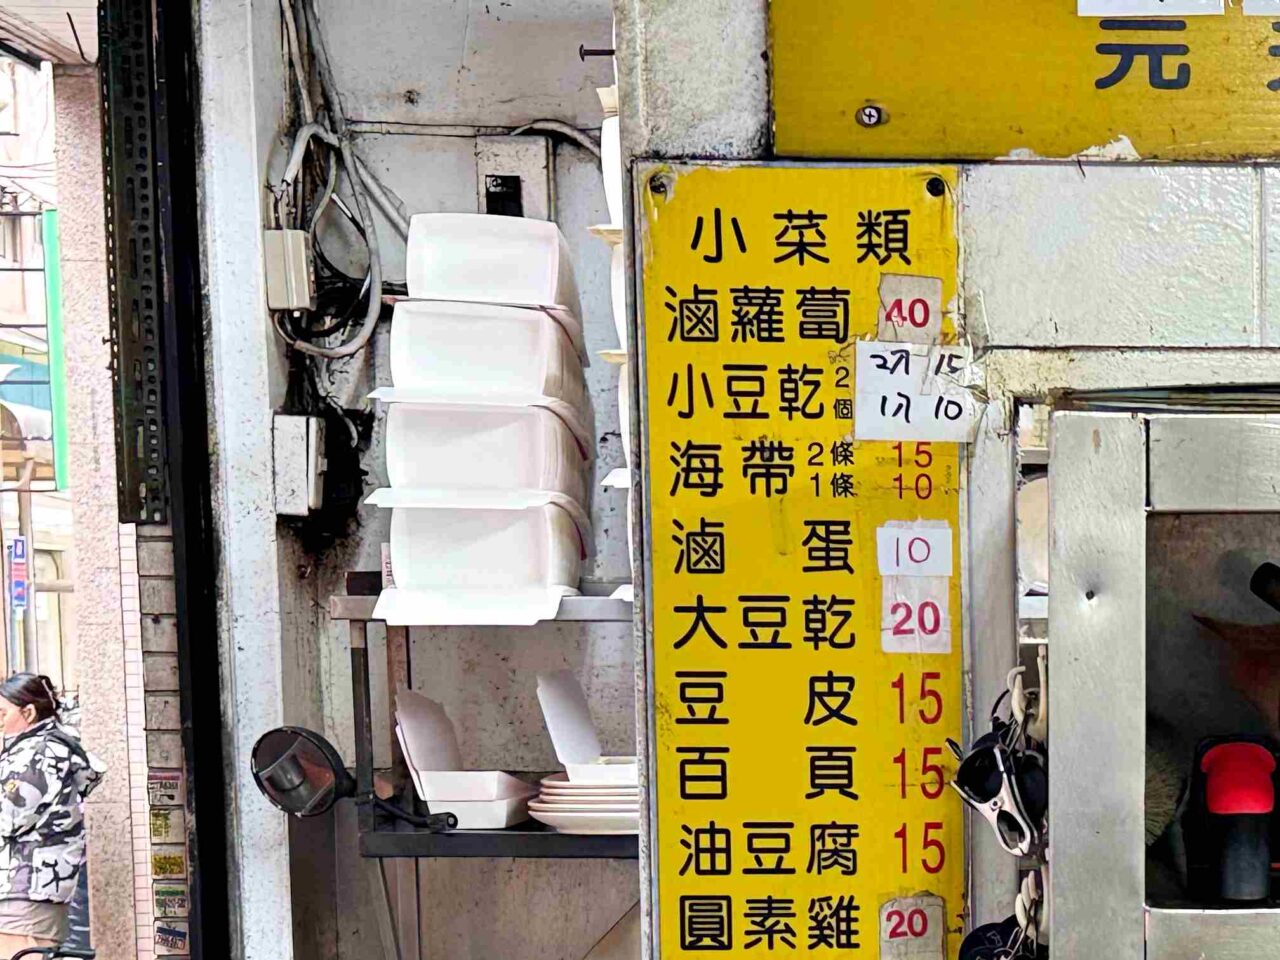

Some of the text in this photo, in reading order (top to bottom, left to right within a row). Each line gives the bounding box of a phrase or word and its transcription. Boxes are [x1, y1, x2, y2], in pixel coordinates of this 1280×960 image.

[1095, 19, 1191, 90] 元
[690, 207, 912, 266] 小菜類
[664, 284, 930, 344] 滷蘿蔔 40
[667, 363, 825, 421] 小豆乾
[934, 395, 964, 421] 10
[669, 439, 795, 498] 海帶
[892, 442, 933, 468] 15
[892, 474, 933, 500] 10
[895, 537, 931, 567] 10
[673, 594, 941, 651] 大豆乾 20
[675, 670, 943, 727] 豆皮 15
[893, 747, 945, 800] 15
[679, 820, 946, 877] 油豆腐 15
[679, 895, 929, 950] 圓素雞 20
